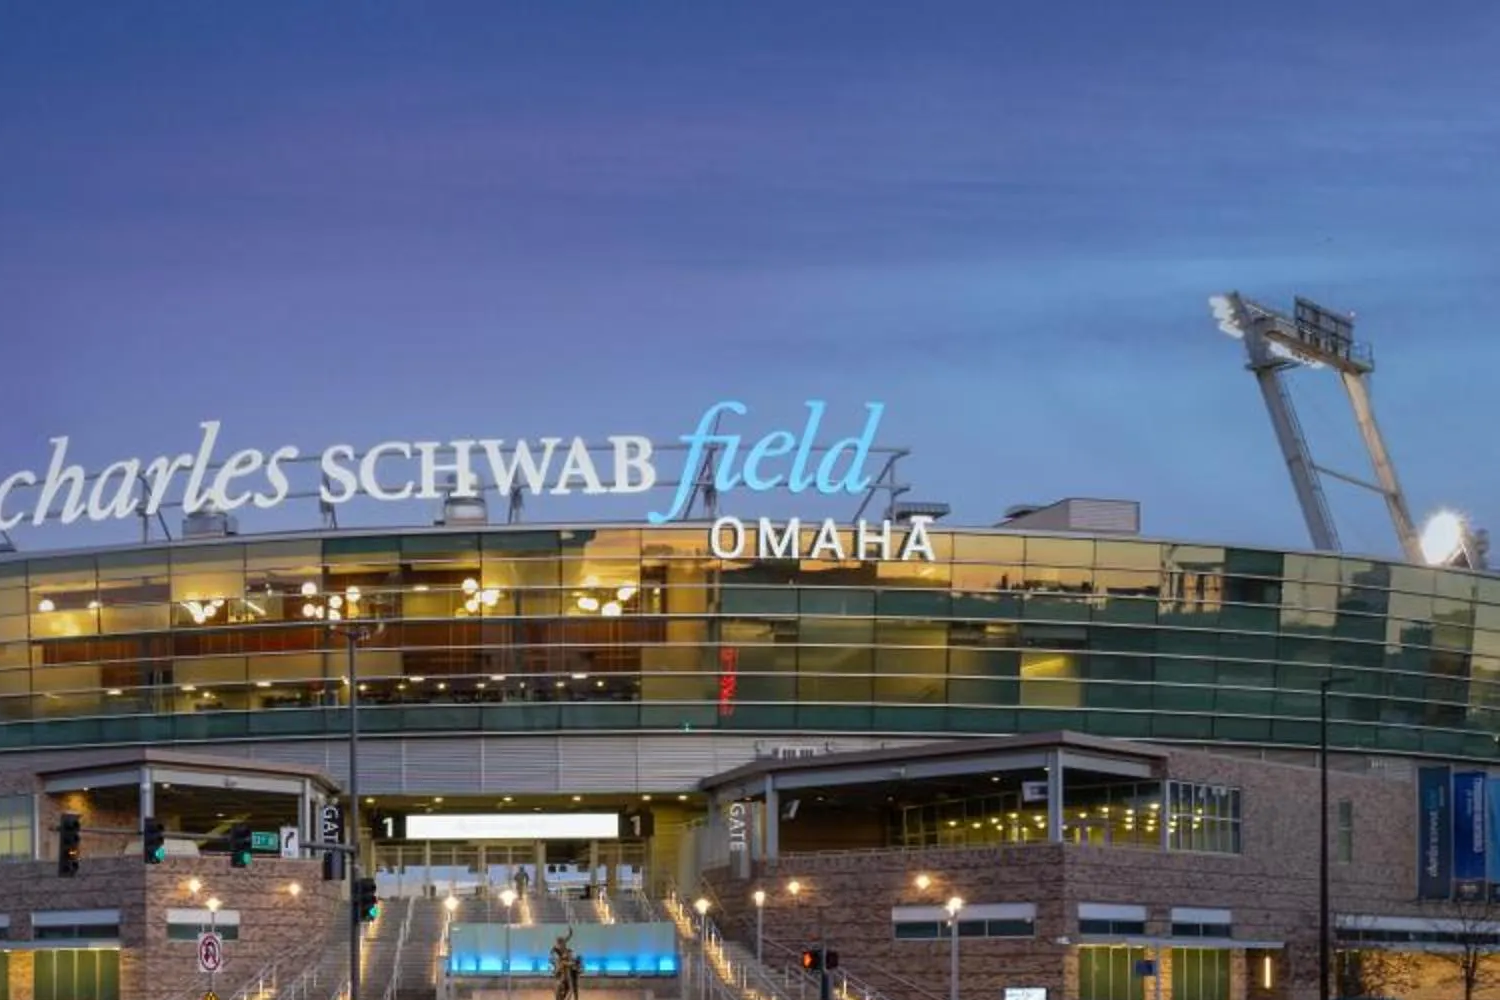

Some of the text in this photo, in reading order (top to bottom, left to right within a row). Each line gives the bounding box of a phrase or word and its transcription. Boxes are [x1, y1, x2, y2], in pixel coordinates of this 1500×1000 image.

[318, 435, 657, 504] SCHWAB
[647, 398, 887, 525] field
[709, 513, 937, 561] OMAHA
[323, 806, 340, 846] GAT
[382, 817, 394, 838] 1
[630, 815, 642, 836] 1
[729, 803, 746, 852] GATE
